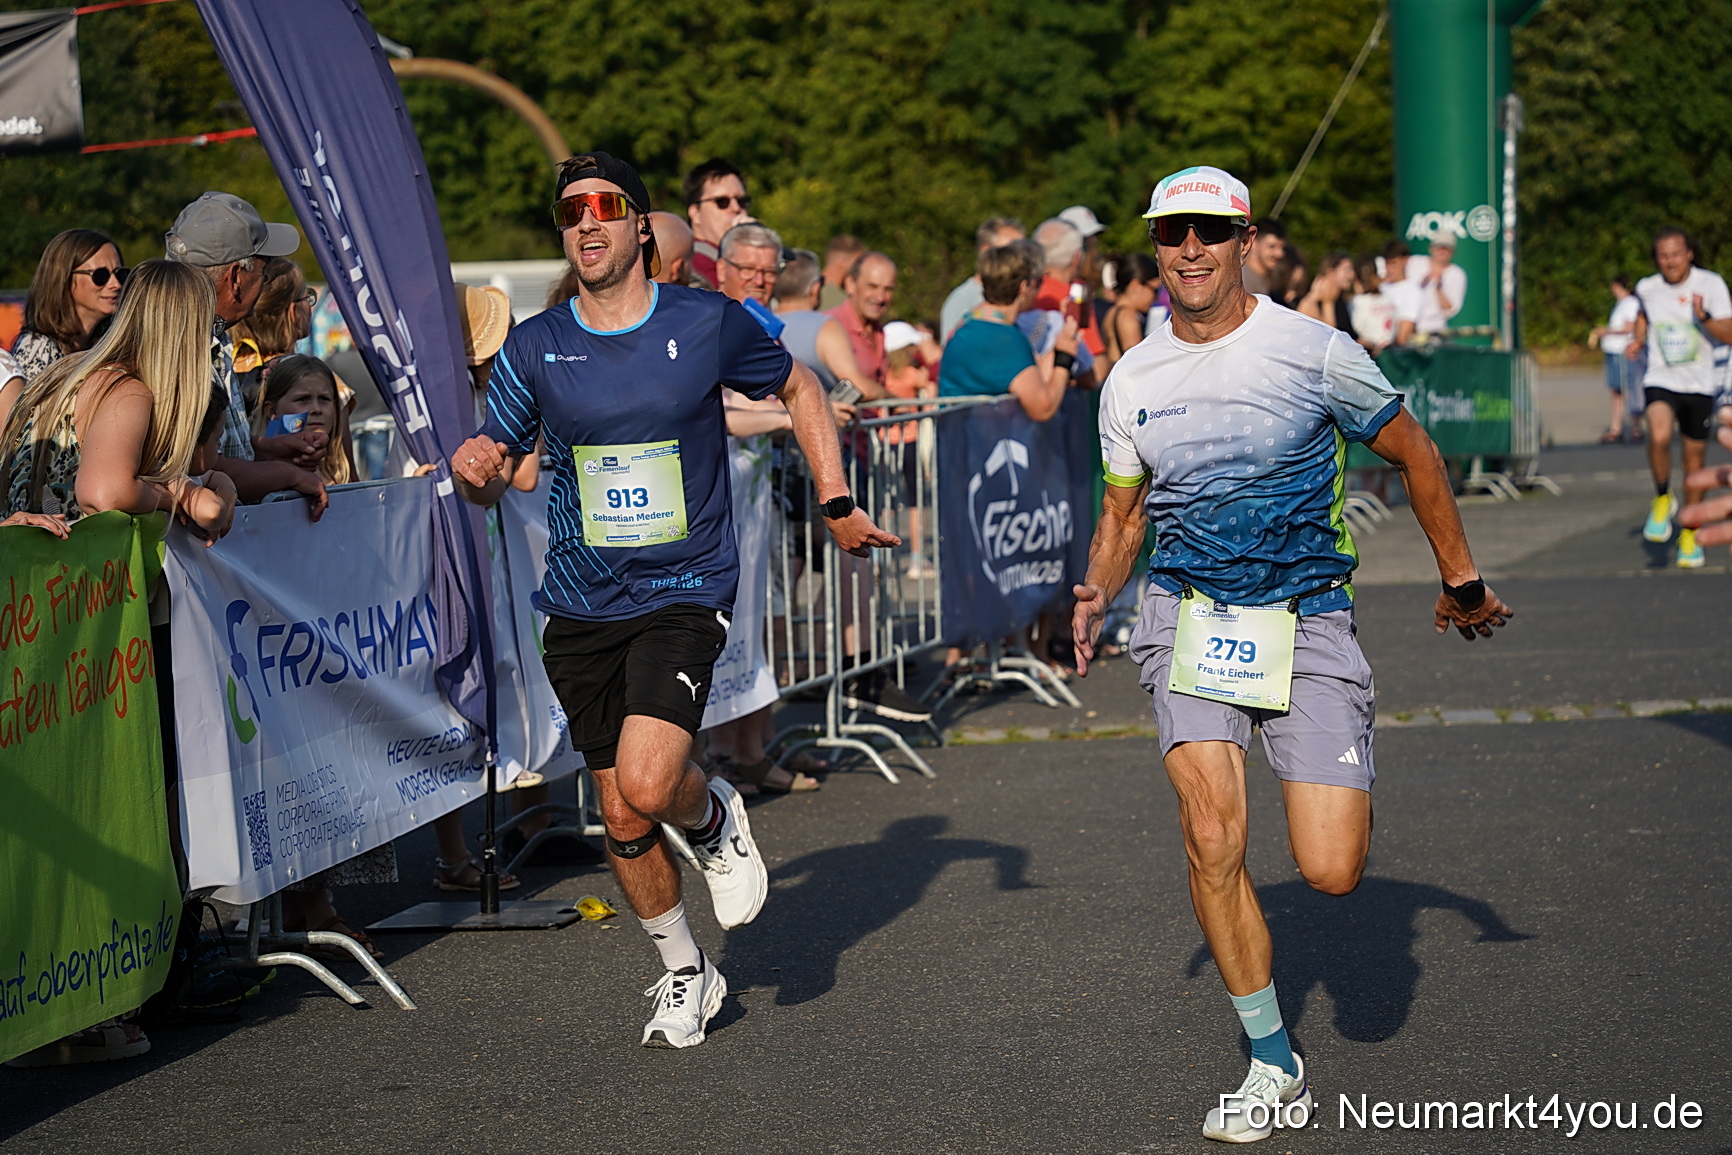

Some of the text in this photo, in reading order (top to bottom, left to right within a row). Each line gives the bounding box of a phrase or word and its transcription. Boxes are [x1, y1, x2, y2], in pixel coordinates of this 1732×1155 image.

[1166, 182, 1222, 200] INCYLENCE
[1405, 210, 1467, 241] AOK
[606, 487, 649, 509] 913
[592, 510, 675, 523] Sebastian Mederer
[681, 571, 693, 581] IS
[0, 563, 138, 651] de Firmen
[1207, 611, 1240, 620] Firmenlauf
[1205, 637, 1257, 664] 279
[1197, 663, 1265, 681] Frank Eichert
[387, 733, 441, 766] HEUTE
[396, 766, 441, 806] MORGEN
[278, 795, 331, 832] CORPORATE
[280, 820, 333, 859] CORPORATE
